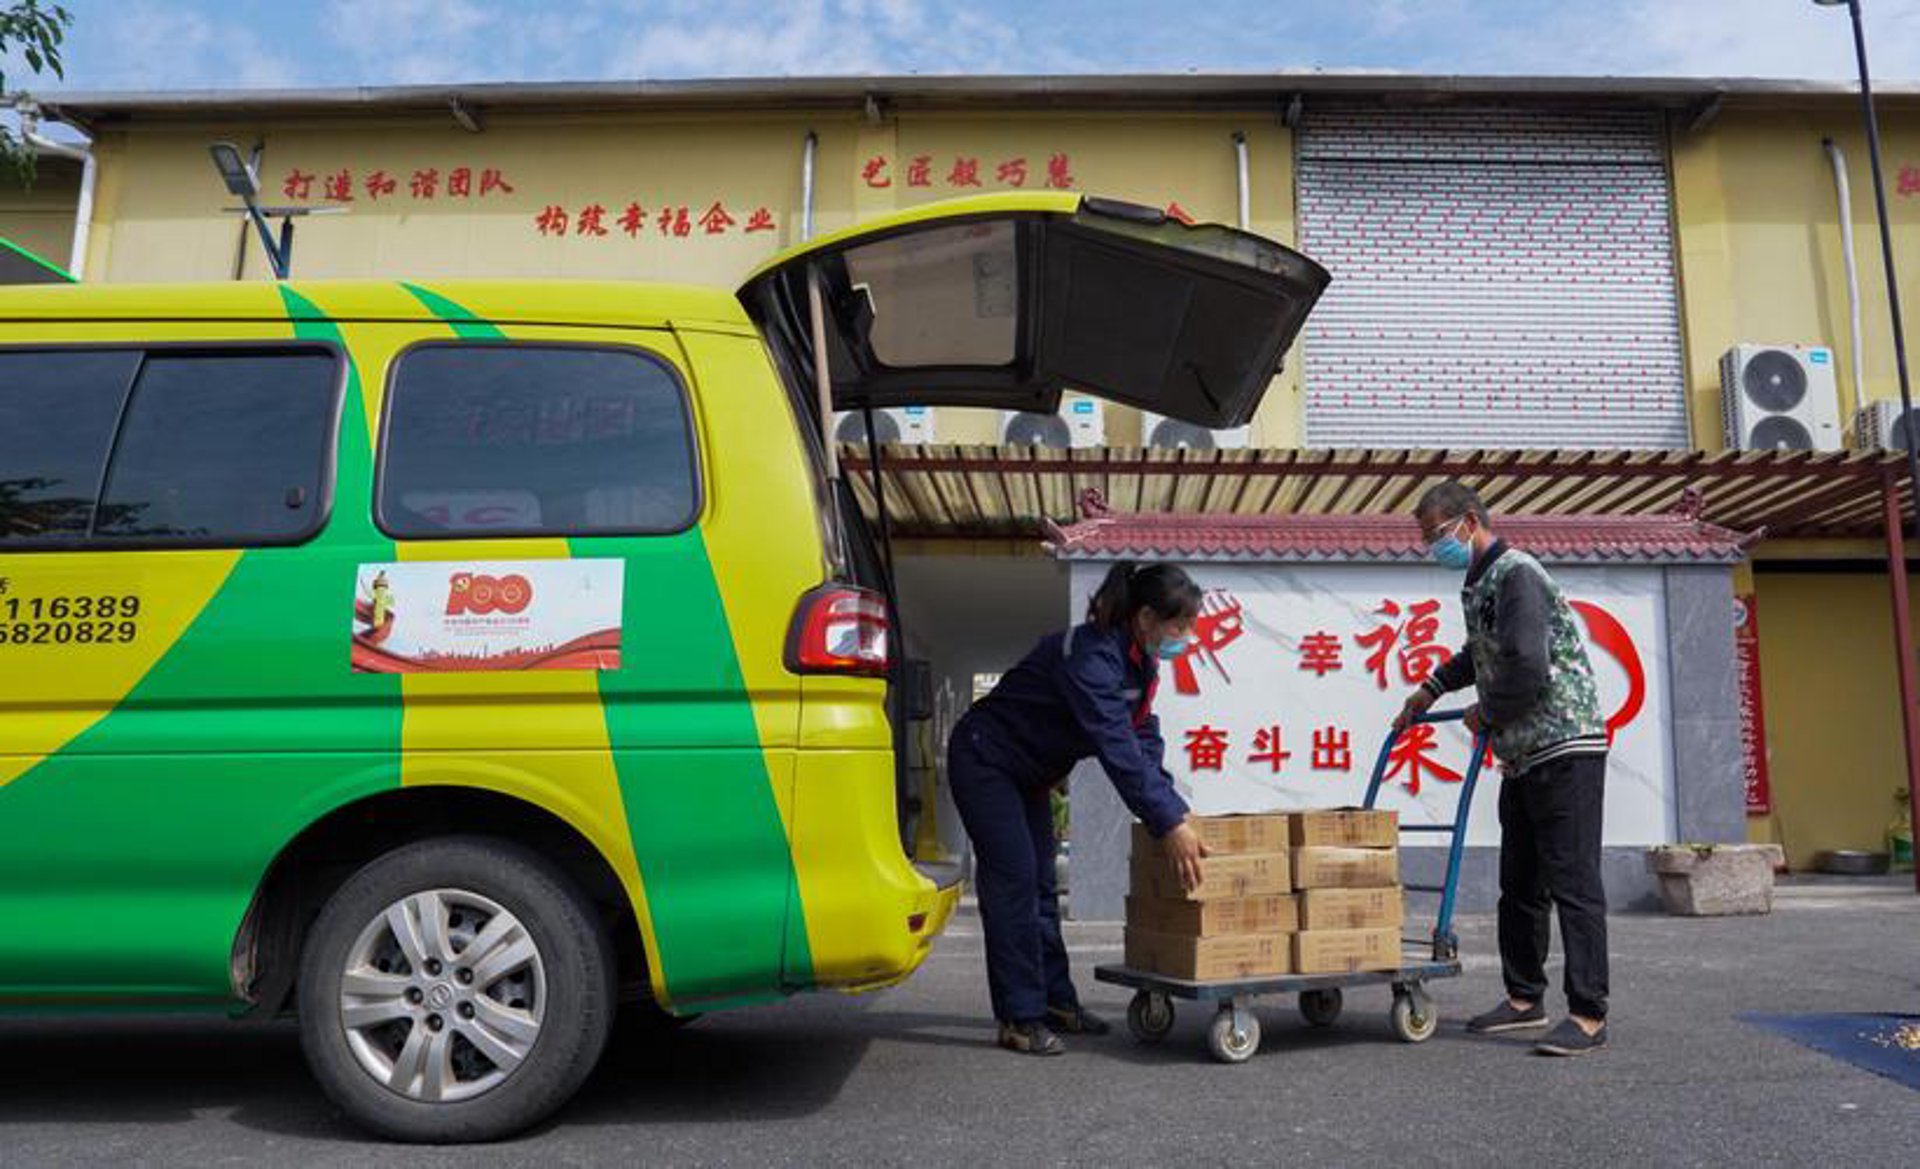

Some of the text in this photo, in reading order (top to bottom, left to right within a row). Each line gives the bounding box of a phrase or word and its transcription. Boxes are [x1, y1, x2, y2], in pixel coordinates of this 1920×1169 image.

[285, 168, 513, 200] 打造和谐团队
[536, 202, 775, 237] 构筑幸福企业
[447, 573, 531, 615] 100
[1299, 598, 1453, 690] 幸福
[1184, 723, 1493, 797] 奋斗出来
